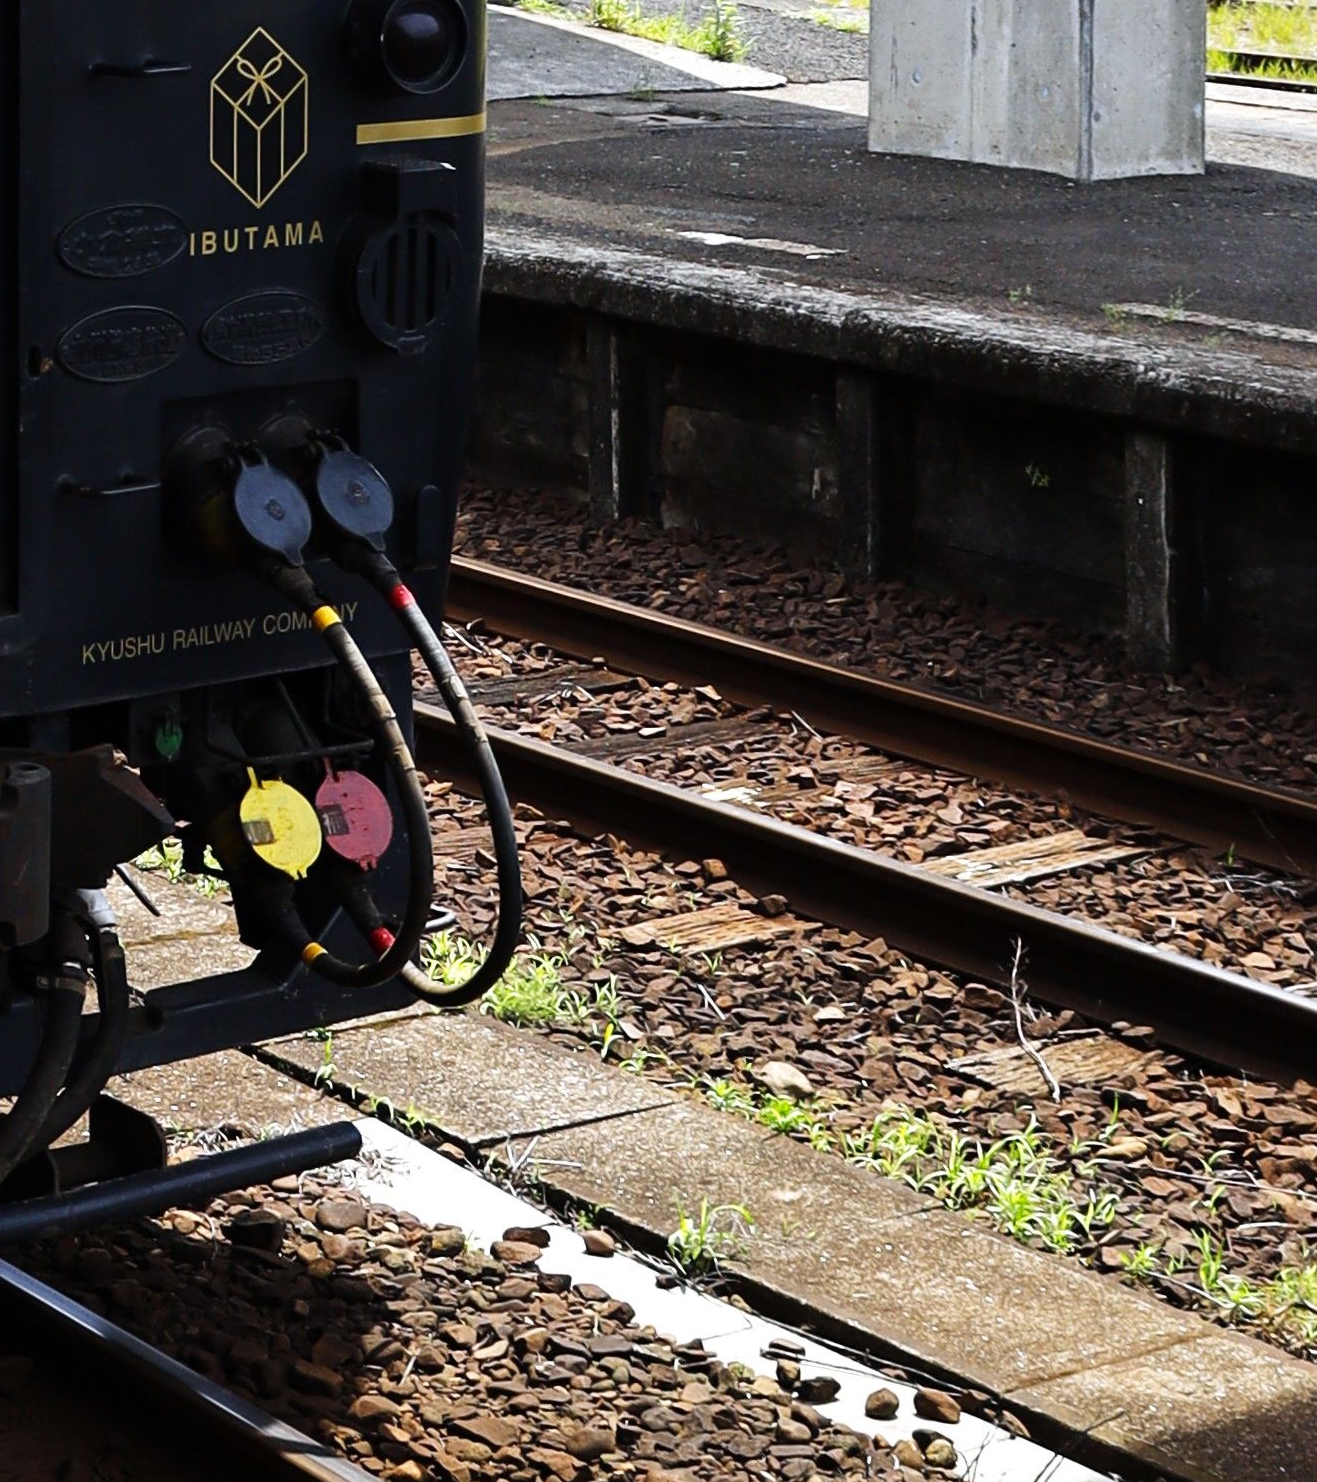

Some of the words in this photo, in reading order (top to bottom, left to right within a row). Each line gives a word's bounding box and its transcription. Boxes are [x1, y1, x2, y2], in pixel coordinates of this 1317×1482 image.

[188, 221, 325, 257] IBUTAMA
[82, 632, 165, 665] KYUSHU
[172, 617, 256, 651] RAILWAY
[262, 601, 359, 635] COMNY
